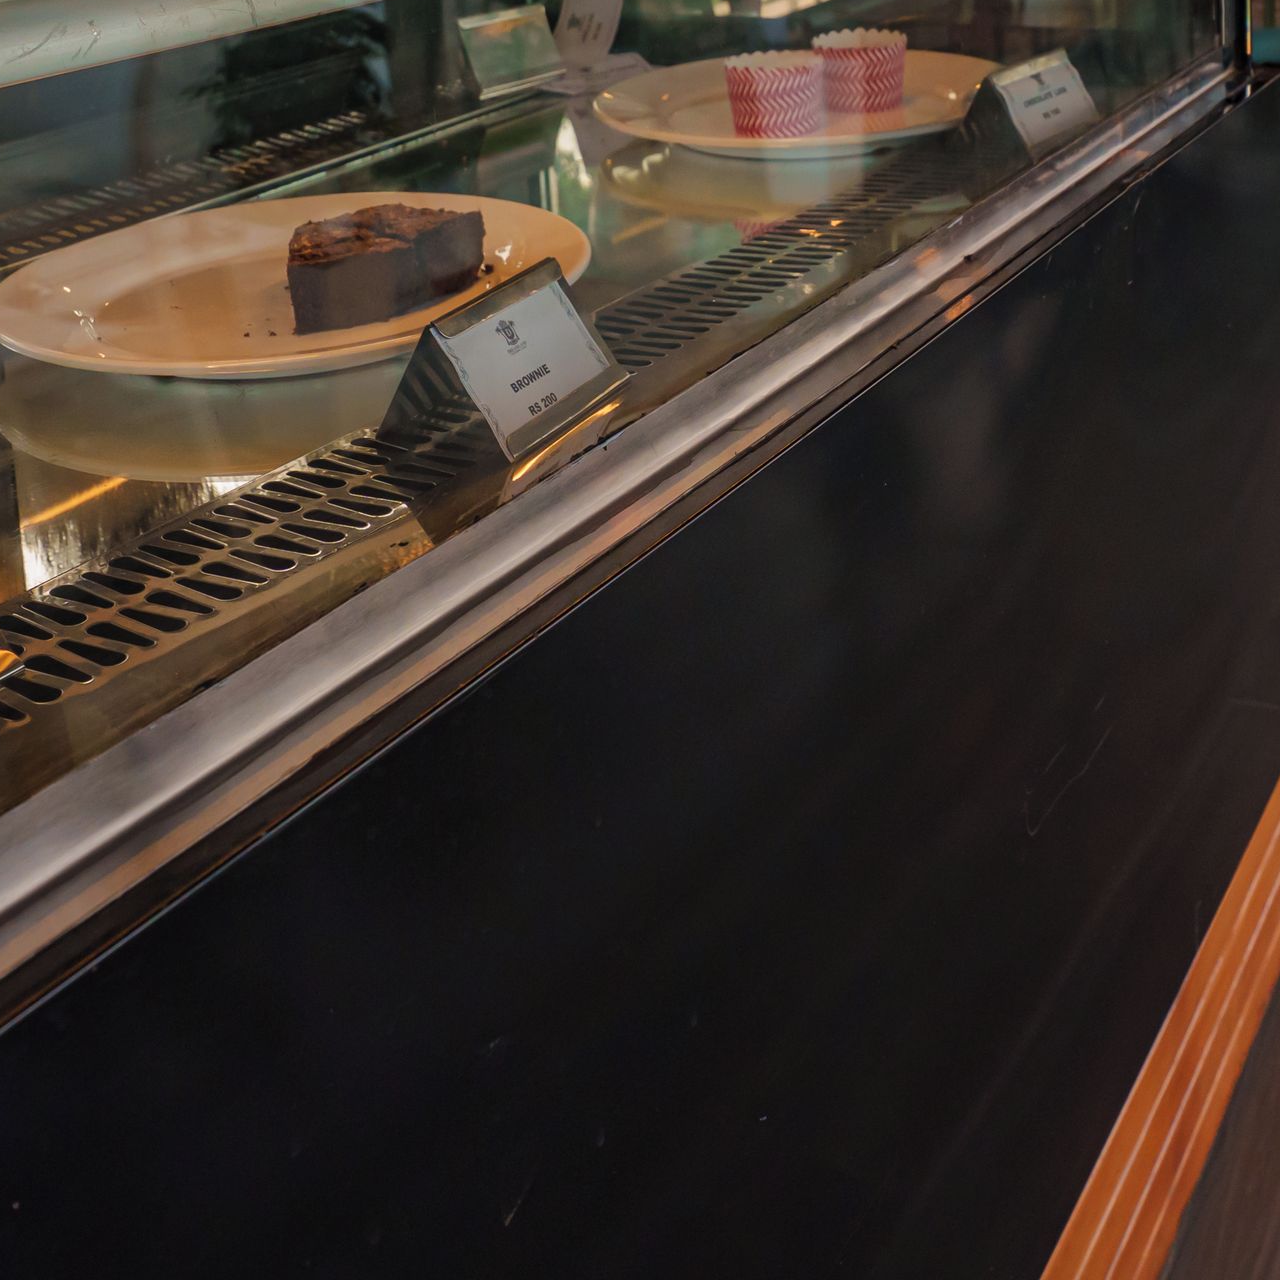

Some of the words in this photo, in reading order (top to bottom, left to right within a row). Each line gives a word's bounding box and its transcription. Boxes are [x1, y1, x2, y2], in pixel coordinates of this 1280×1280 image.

[510, 363, 551, 394] BROWNIE
[528, 402, 543, 417] RS
[541, 392, 558, 408] 200
